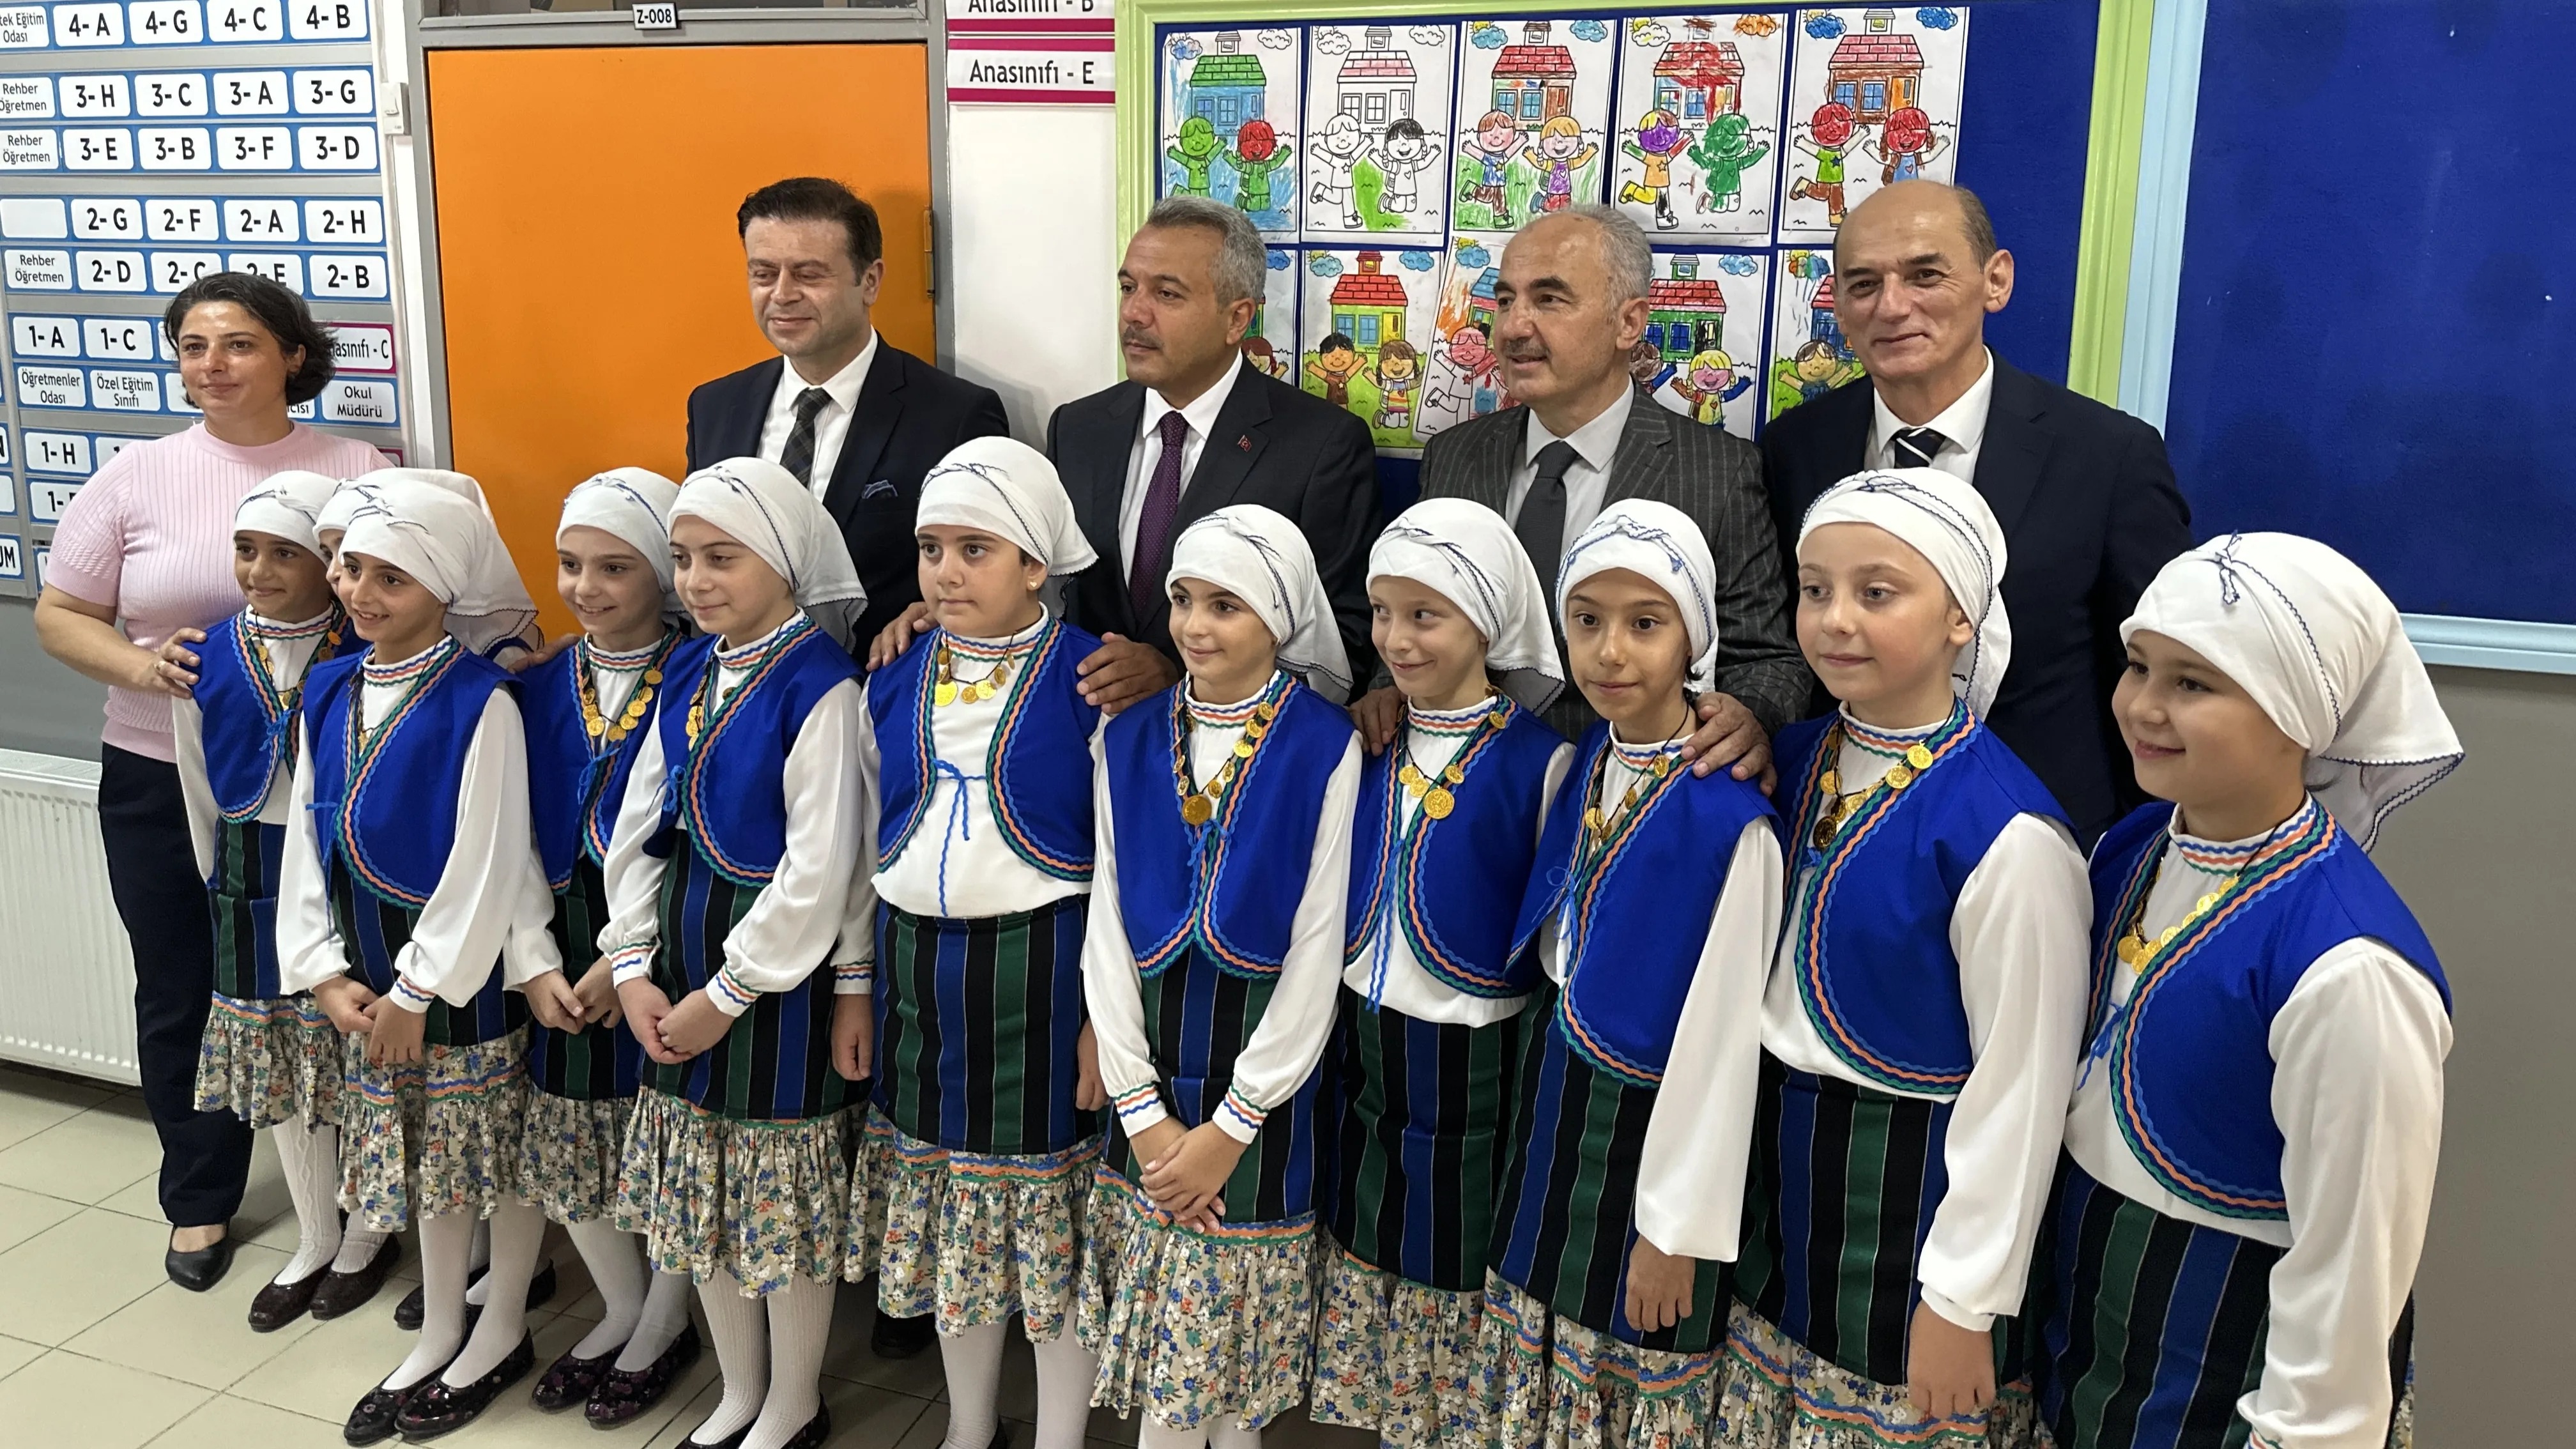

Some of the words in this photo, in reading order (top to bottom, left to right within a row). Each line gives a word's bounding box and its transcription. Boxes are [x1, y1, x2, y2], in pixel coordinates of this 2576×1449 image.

[15, 12, 44, 28] Eğitim
[636, 9, 672, 26] Z-008
[3, 29, 28, 43] Odası
[969, 59, 1059, 84] Anasınıfı
[1082, 61, 1094, 85] E
[2, 82, 38, 95] Rehber
[7, 134, 43, 146] Rehber
[3, 149, 50, 165] Öğretmen
[19, 254, 56, 266] Rehber
[15, 268, 64, 284] Öğretmen
[381, 339, 389, 359] C
[21, 368, 80, 388] Öğretmenler
[96, 372, 119, 390] Özel
[121, 376, 153, 394] Eğitim
[40, 390, 66, 405] Odası
[344, 385, 372, 399] Okul
[114, 393, 140, 408] Sınıfı
[337, 404, 383, 418] Müdürü
